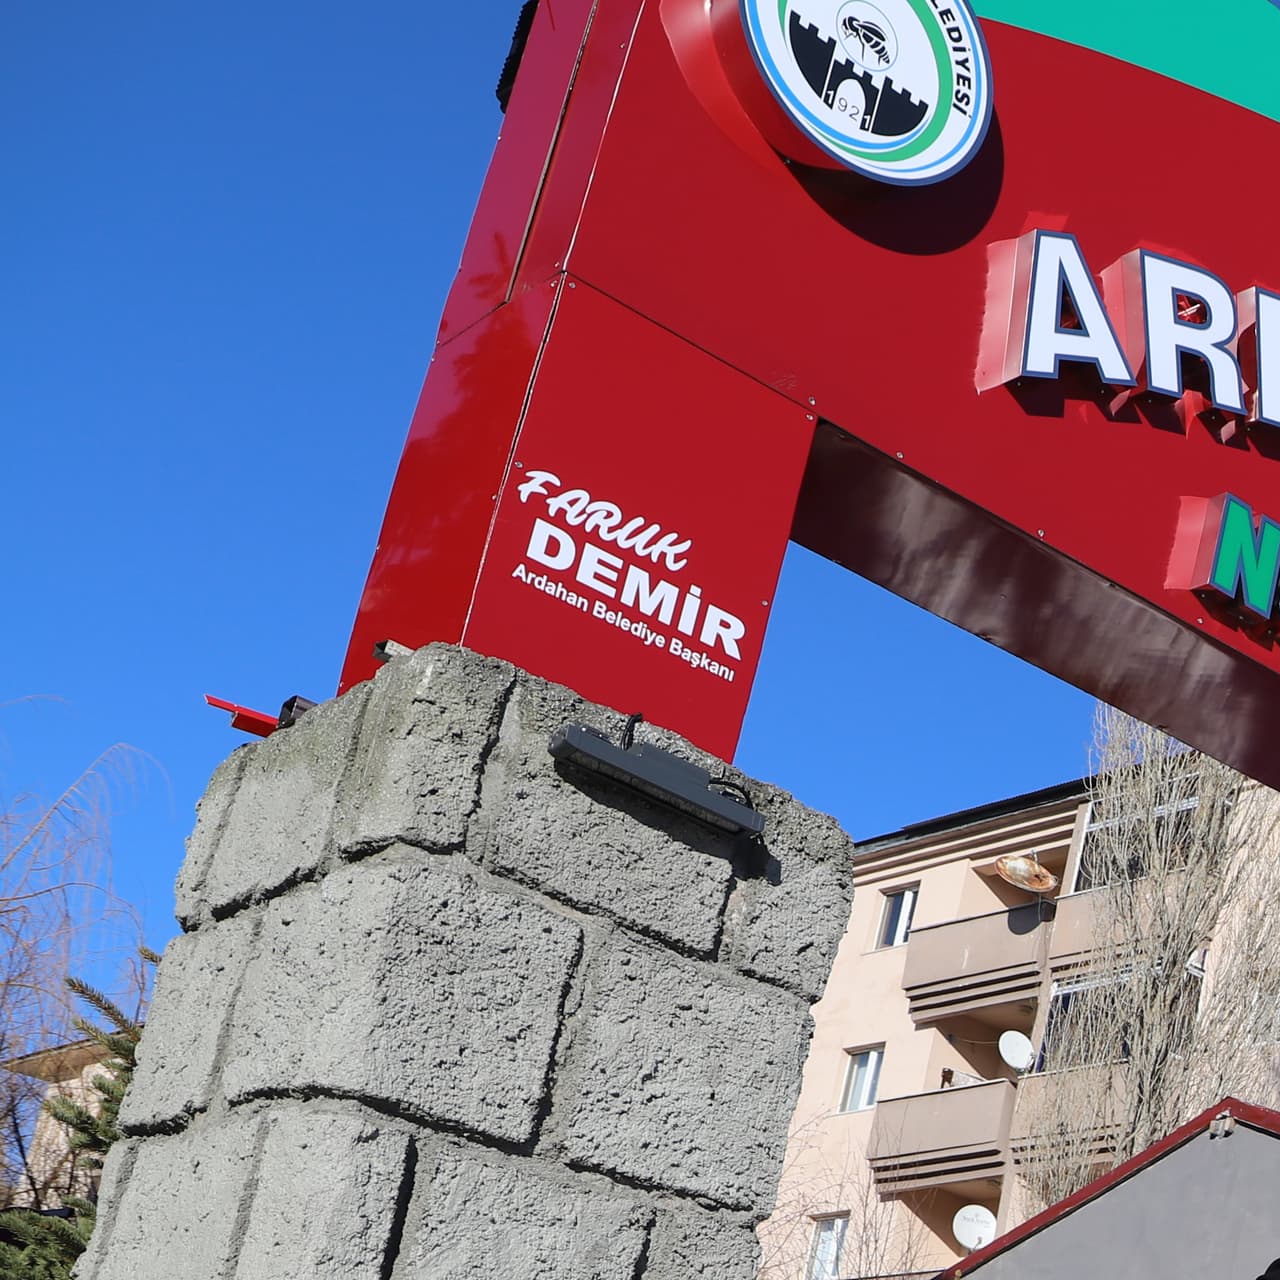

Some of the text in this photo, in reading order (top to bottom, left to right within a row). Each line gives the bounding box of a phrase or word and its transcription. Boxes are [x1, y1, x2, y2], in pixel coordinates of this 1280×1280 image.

[826, 90, 871, 129] 1921
[930, 0, 971, 119] EDİYESİ
[517, 470, 692, 571] FARUK
[512, 563, 735, 682] Ardahan Belediye Başkanı
[526, 517, 746, 661] DEMİR
